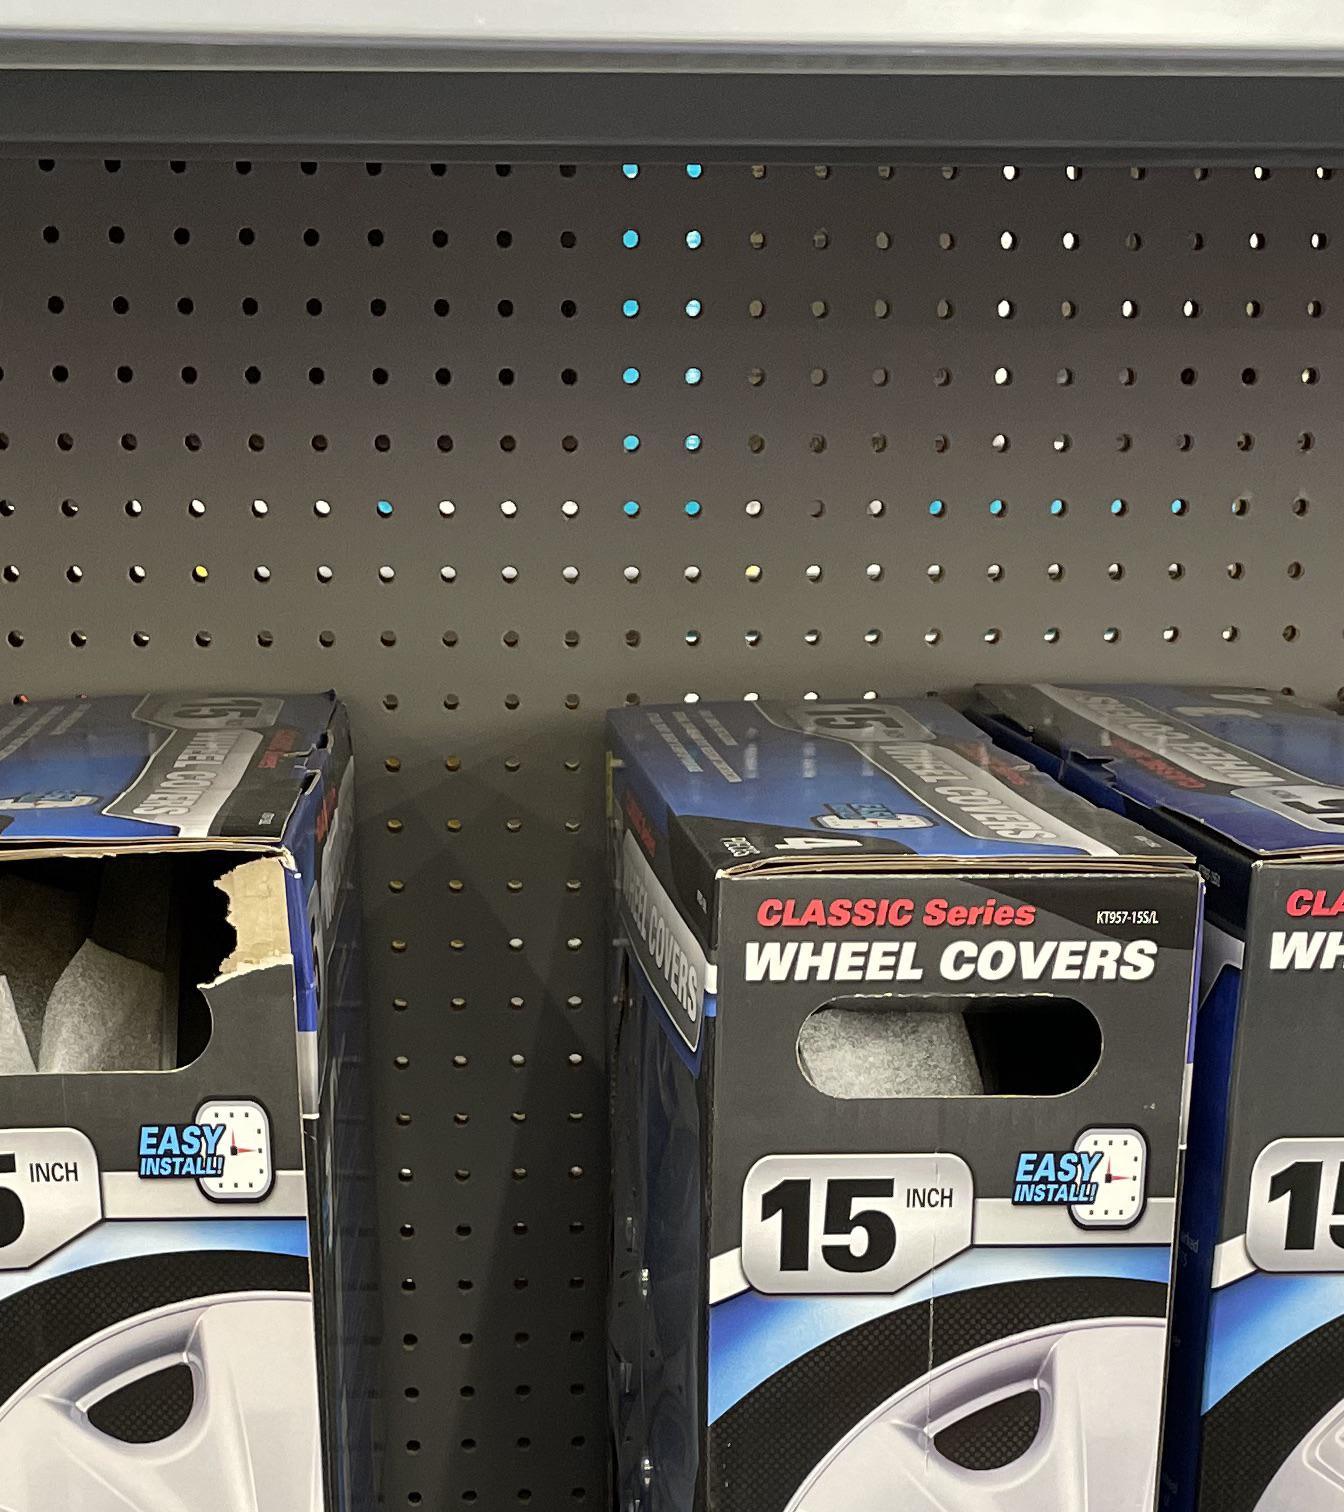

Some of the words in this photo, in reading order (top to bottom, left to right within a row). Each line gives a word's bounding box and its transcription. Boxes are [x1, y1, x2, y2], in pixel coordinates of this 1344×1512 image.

[757, 899, 915, 927] CLASSIC
[924, 899, 1035, 925] Series
[1096, 910, 1158, 925] KT957-15S/L
[745, 943, 924, 982] WHEEL
[940, 940, 1156, 980] COVERS
[140, 1126, 225, 1156] EASY
[29, 1162, 79, 1183] INCH
[1016, 1153, 1102, 1181] EASY
[761, 1177, 896, 1272] 15
[906, 1187, 953, 1209] INCH
